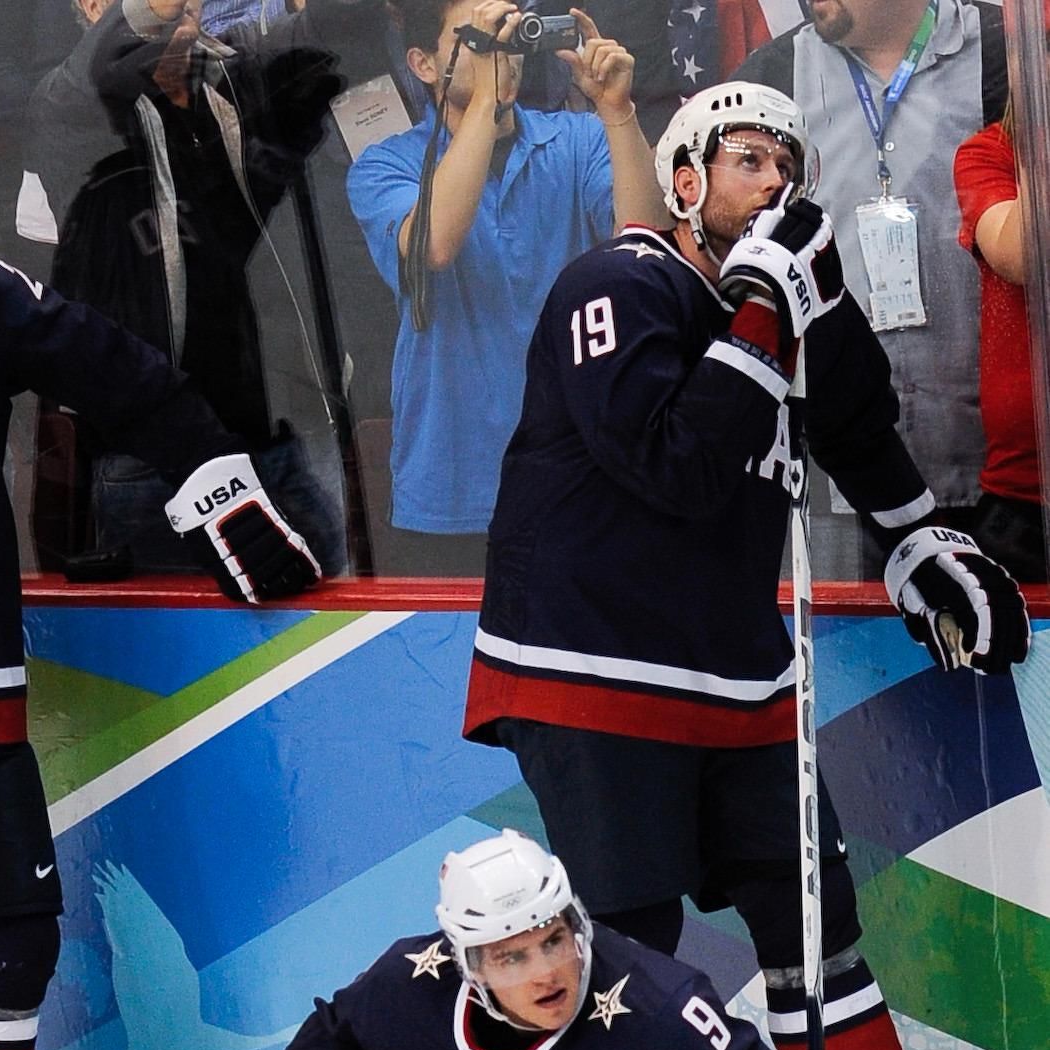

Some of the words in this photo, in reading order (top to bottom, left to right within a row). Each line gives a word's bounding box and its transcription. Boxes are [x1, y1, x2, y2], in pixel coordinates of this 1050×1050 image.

[786, 262, 811, 317] USA
[570, 296, 616, 366] 19
[193, 476, 249, 516] USA
[931, 529, 976, 549] USA
